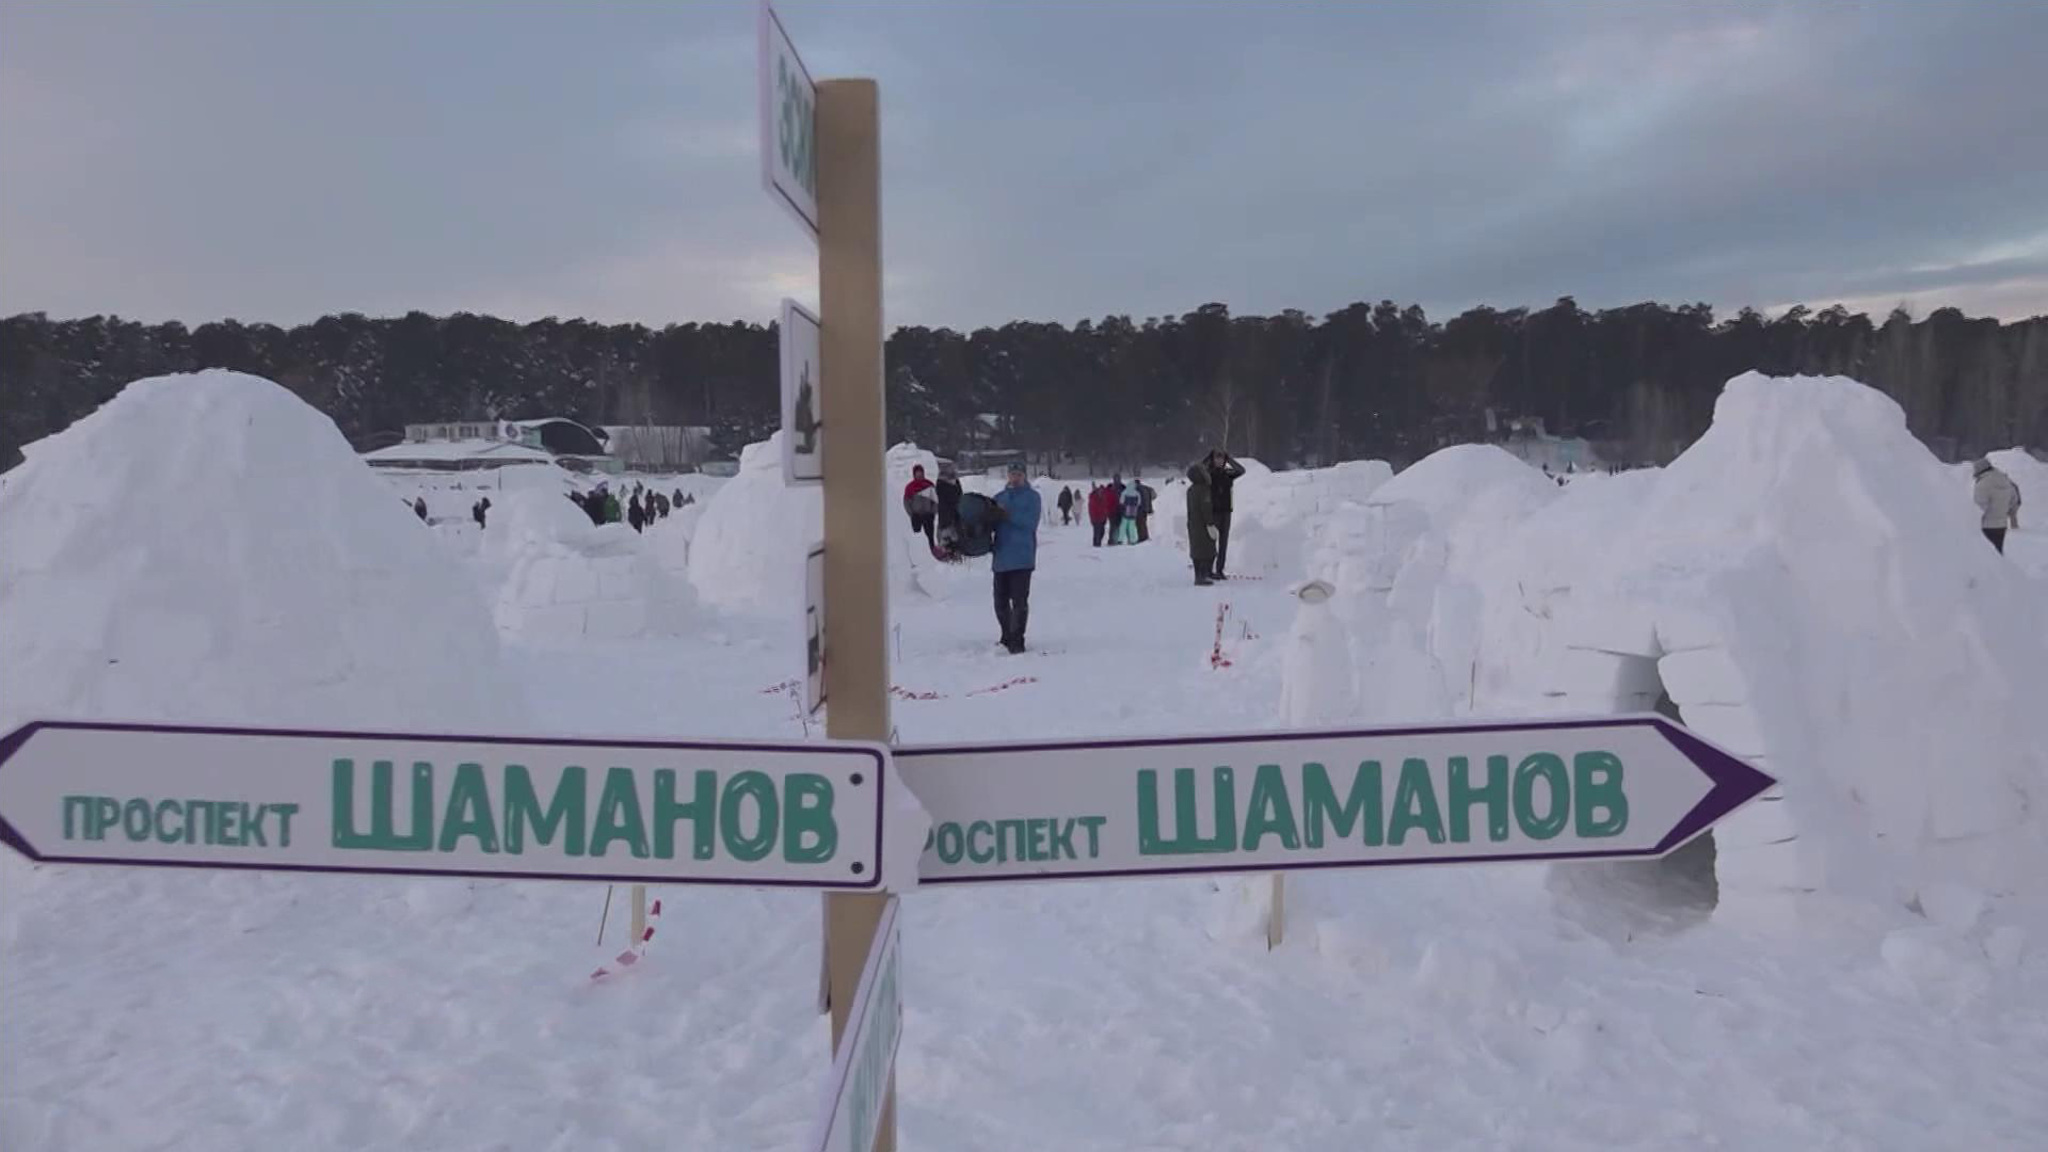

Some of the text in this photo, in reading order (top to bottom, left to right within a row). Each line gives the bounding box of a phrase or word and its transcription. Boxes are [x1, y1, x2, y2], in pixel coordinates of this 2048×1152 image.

[62, 758, 838, 864] ПРОСПЕКТ ШАМАНОВ
[1136, 750, 1630, 856] ШАМАНОВ
